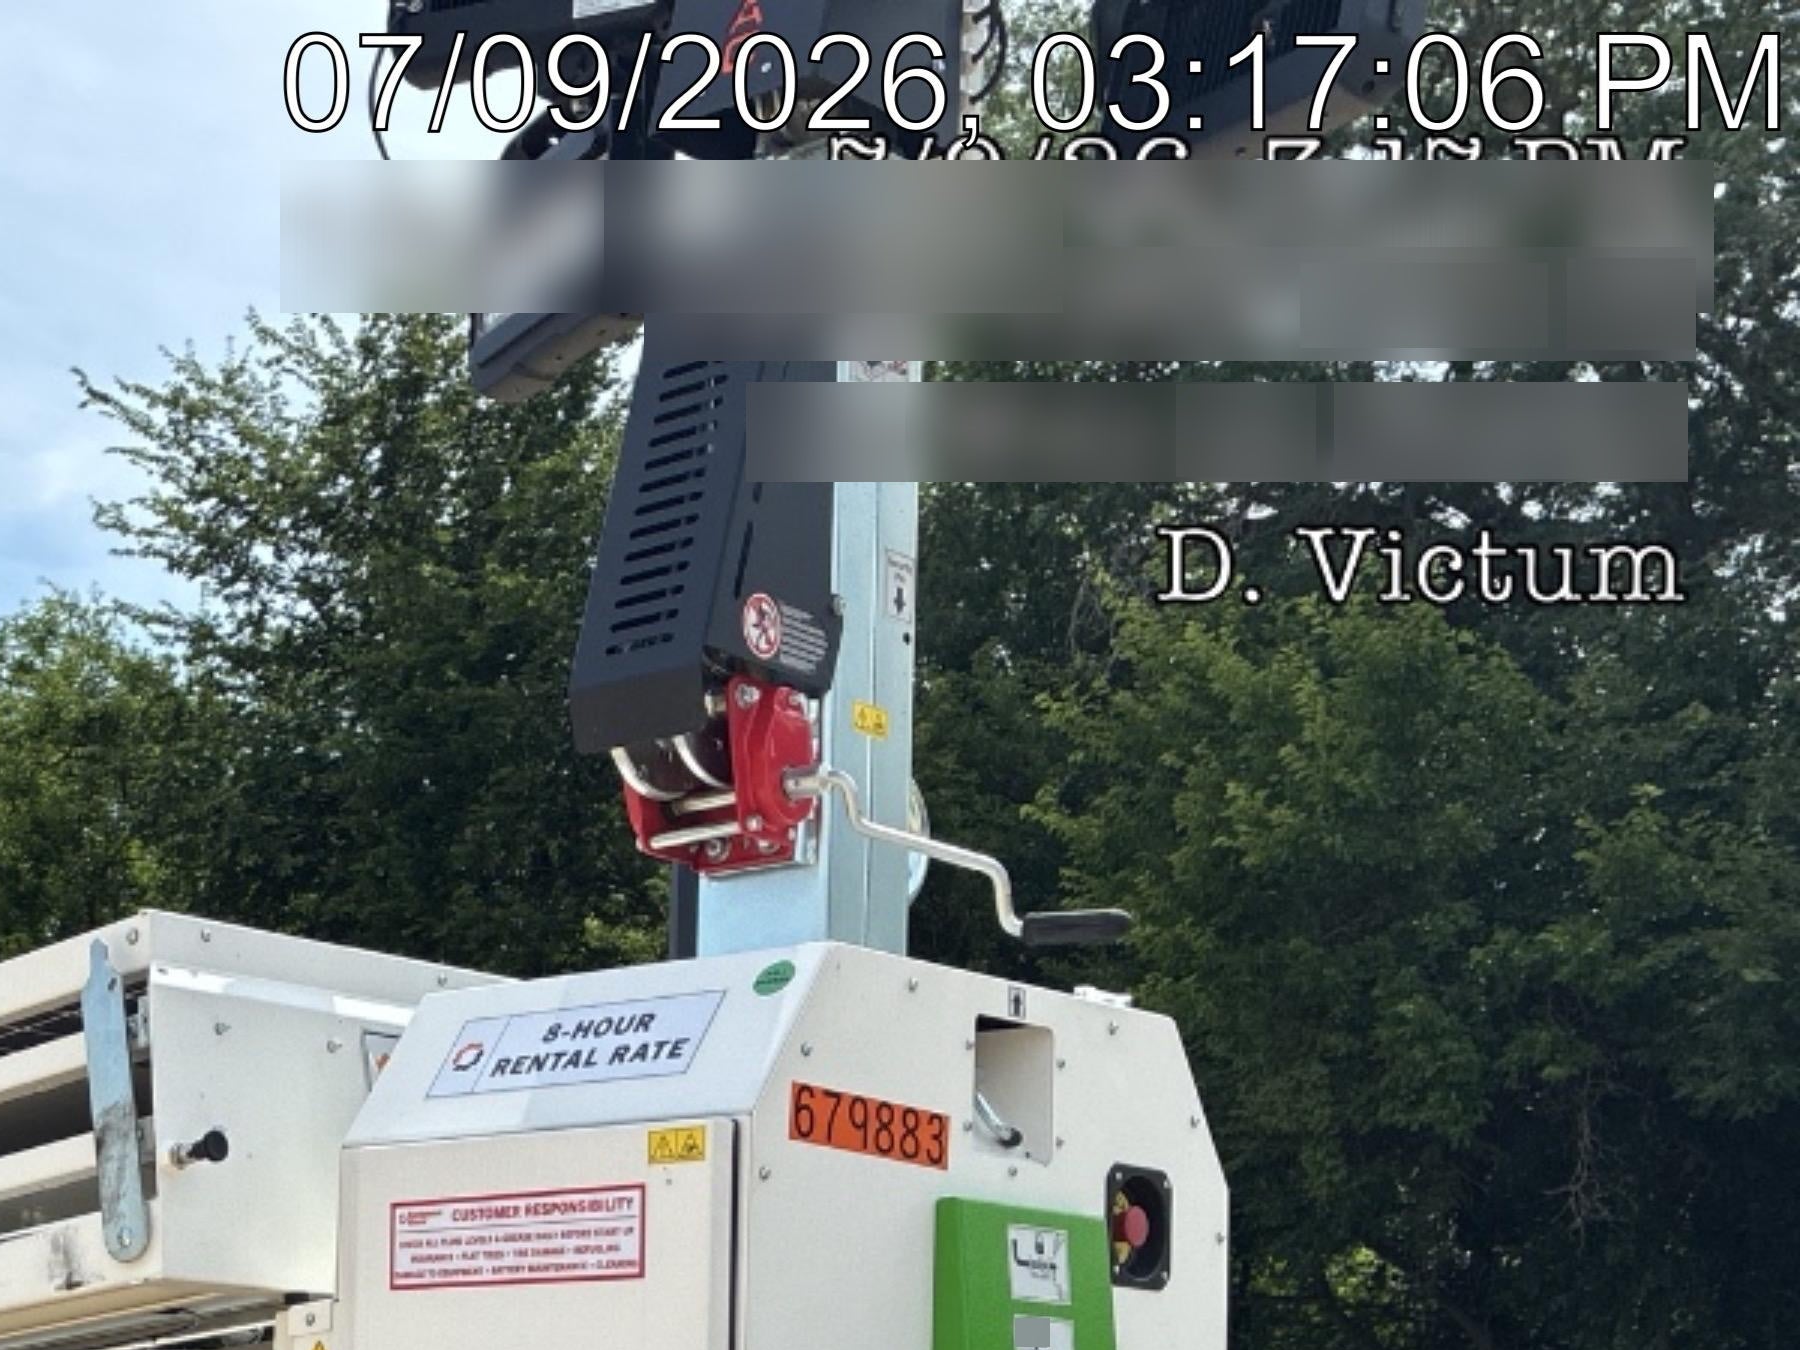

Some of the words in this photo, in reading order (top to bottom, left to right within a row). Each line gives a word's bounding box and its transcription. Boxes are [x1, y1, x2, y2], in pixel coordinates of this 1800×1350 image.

[541, 1012, 657, 1043] 8-HOUR
[489, 1048, 599, 1078] RENTAL
[607, 1037, 691, 1066] RATE
[794, 1083, 944, 1165] 679883
[452, 1205, 521, 1222] CUSTOMER
[524, 1196, 634, 1217] RESPONSIBILITY
